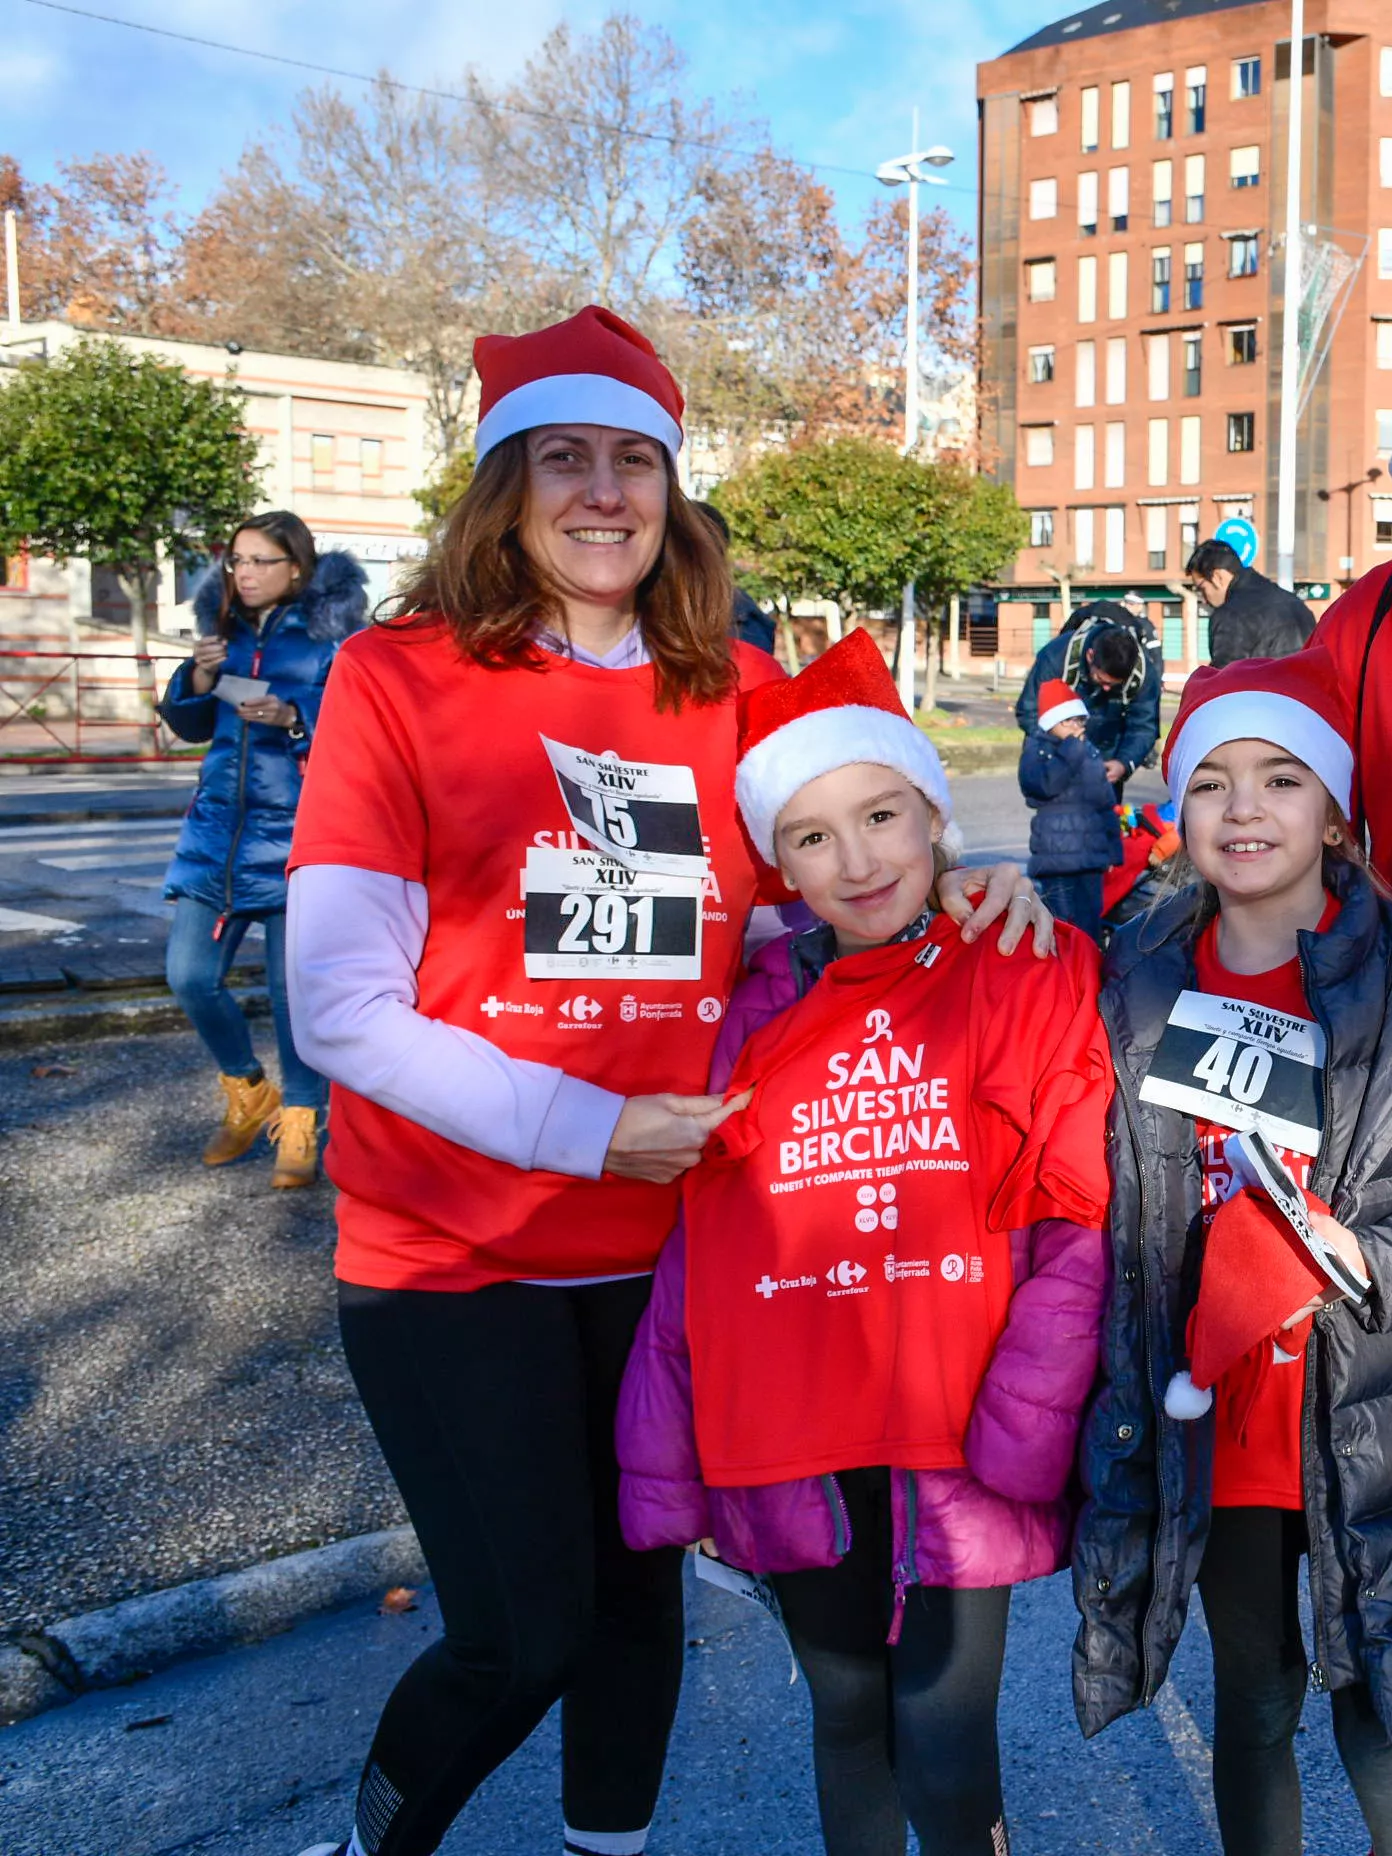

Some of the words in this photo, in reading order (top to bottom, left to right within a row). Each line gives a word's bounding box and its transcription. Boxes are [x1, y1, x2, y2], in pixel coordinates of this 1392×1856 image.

[576, 756, 596, 767] SAN
[598, 764, 649, 776] SILVESTRE
[597, 771, 636, 790] XLIV
[572, 857, 595, 866] SAN
[595, 869, 638, 885] XLIV
[558, 893, 654, 954] 291
[702, 912, 728, 922] ANDO
[506, 1002, 522, 1013] Cruz
[524, 1002, 544, 1016] Roja
[640, 1010, 682, 1022] Ponferrada
[1221, 1002, 1246, 1014] SAN
[1248, 1008, 1308, 1033] SILVESTRE
[558, 1022, 602, 1030] Carrefour
[1238, 1016, 1289, 1044] XLIV
[826, 1043, 924, 1090] SAN
[1192, 1035, 1274, 1105] 40
[791, 1078, 948, 1134] SILVESTRE
[779, 1116, 960, 1174] BERCIANA
[770, 1178, 804, 1194] ÚNETE
[805, 1178, 812, 1188] Y
[814, 1168, 873, 1186] COMPARTE
[875, 1164, 905, 1178] TIEMP
[906, 1160, 970, 1172] AYUDANDO
[780, 1278, 800, 1289] Cruz
[800, 1275, 816, 1287] Roja
[826, 1286, 870, 1298] Carrefour
